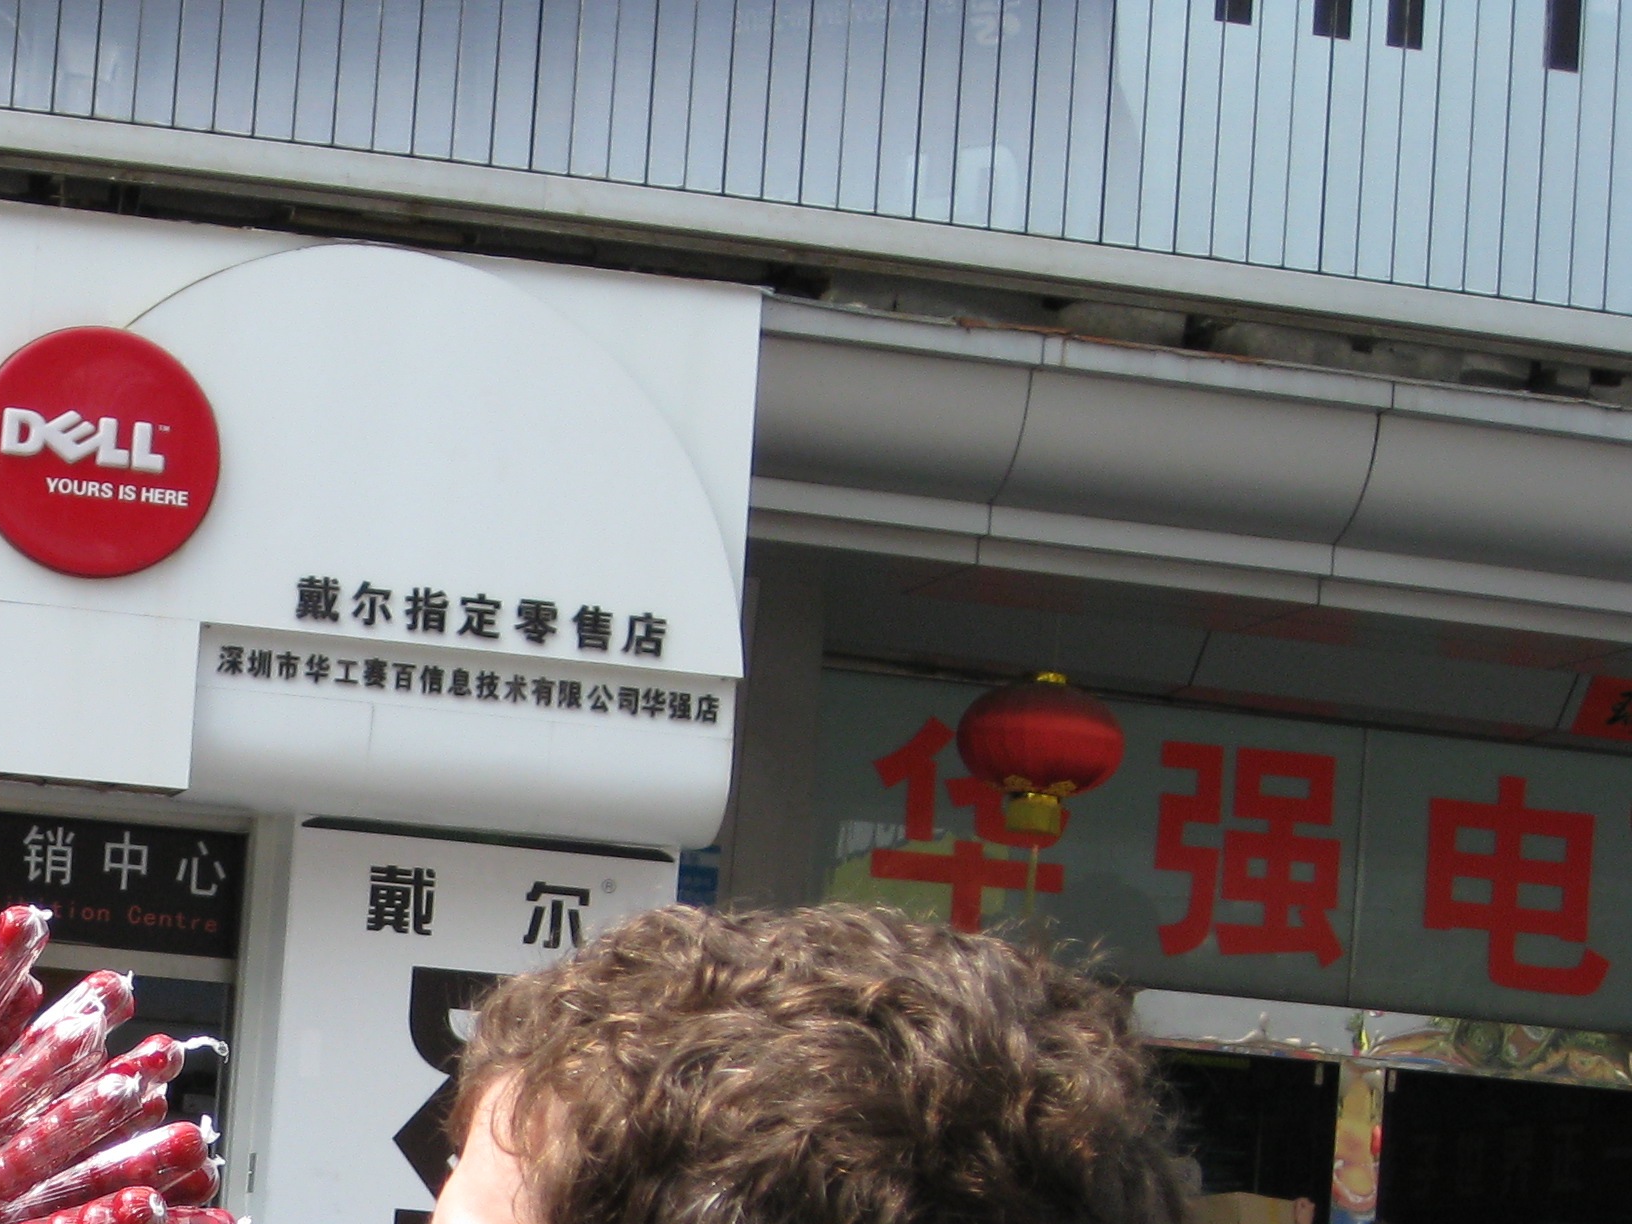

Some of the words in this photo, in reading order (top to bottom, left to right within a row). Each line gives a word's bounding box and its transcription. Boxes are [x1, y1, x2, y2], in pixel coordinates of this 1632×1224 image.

[0, 407, 165, 474] DELL
[46, 477, 113, 499] YOURS
[118, 484, 137, 500] IS
[141, 486, 188, 507] HERE
[296, 576, 667, 656] 戴尔指定零售店
[216, 644, 720, 724] 深圳市华工赛百信息技术有限公司华强店
[870, 714, 1611, 997] 华强电
[126, 904, 218, 934] Centre
[366, 863, 591, 949] 戴尔
